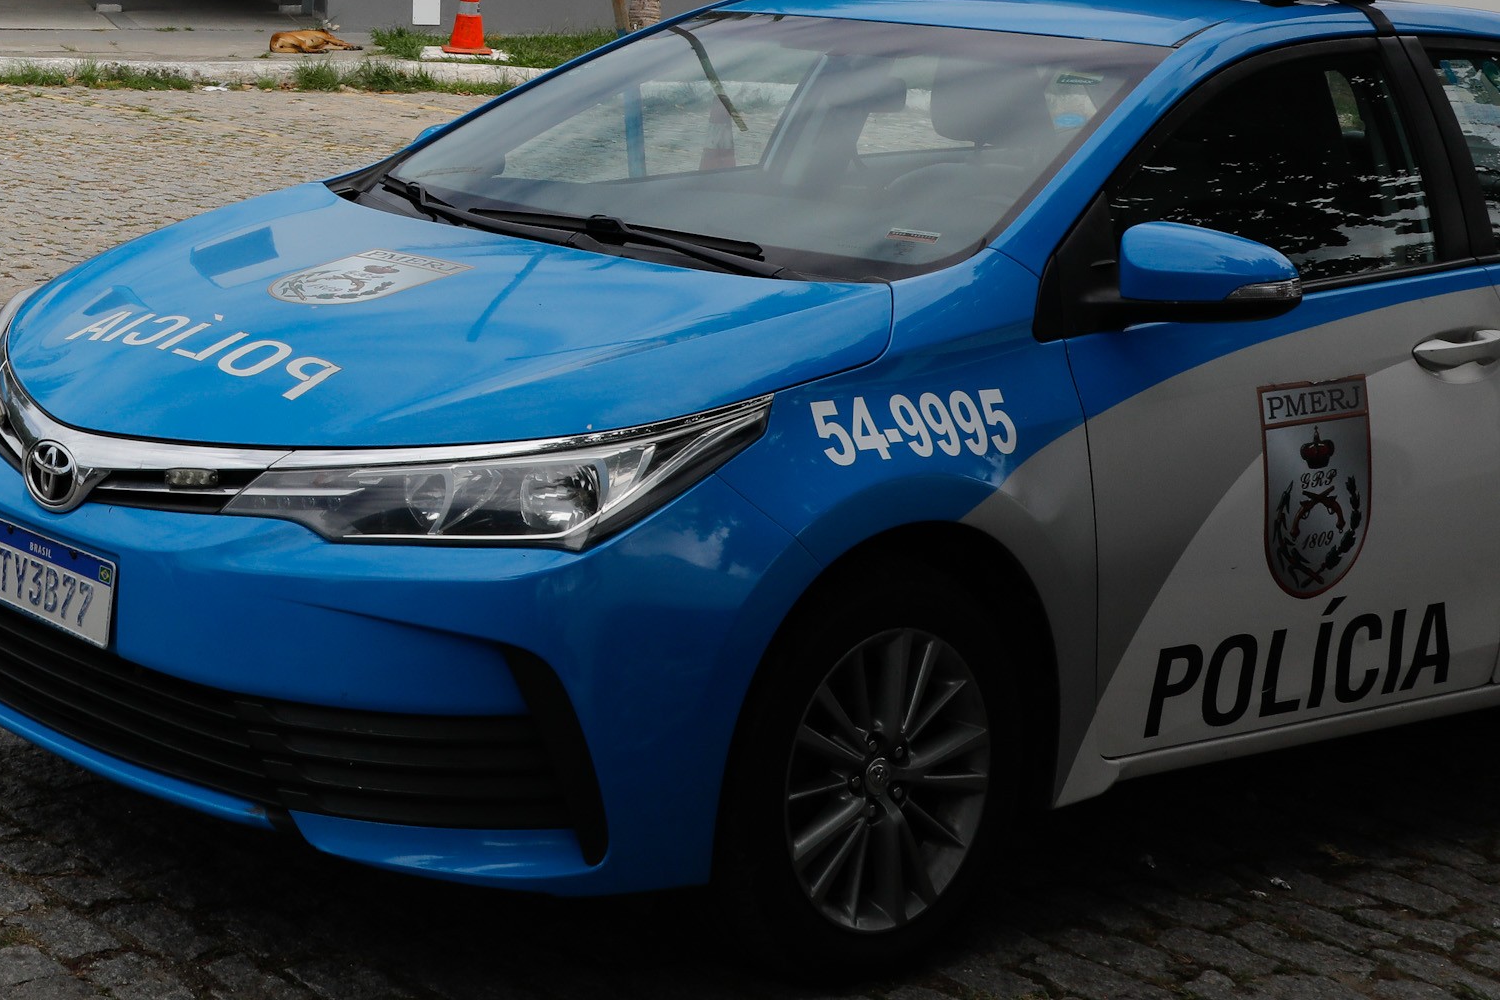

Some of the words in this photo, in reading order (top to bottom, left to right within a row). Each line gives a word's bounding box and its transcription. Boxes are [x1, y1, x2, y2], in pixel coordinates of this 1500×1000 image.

[366, 249, 464, 273] PMERJ
[1266, 386, 1361, 420] PMERJ
[810, 388, 1018, 466] 54-9995
[29, 541, 53, 559] BRASIL
[1301, 529, 1335, 550] 1809
[1143, 595, 1451, 739] POLÍCIA
